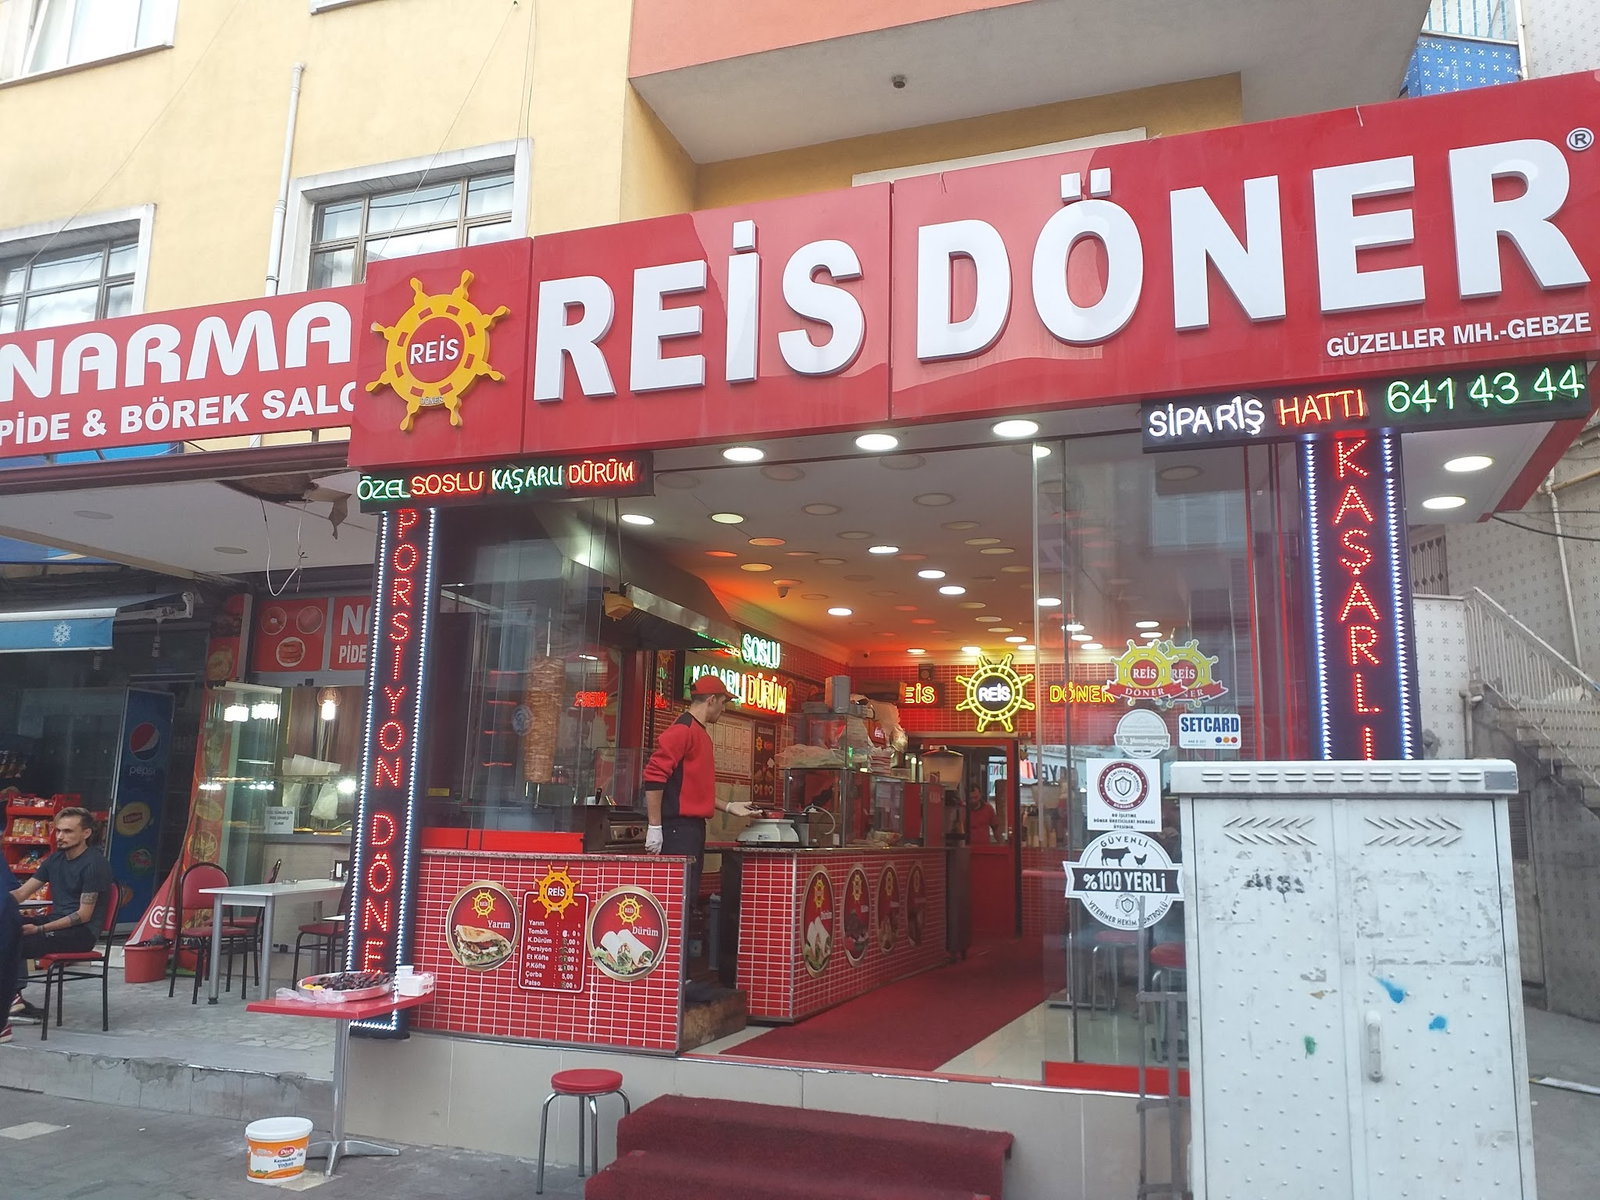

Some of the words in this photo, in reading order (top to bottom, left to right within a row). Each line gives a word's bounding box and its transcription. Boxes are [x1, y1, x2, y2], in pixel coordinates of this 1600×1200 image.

[534, 220, 866, 403] REİS
[917, 139, 1590, 362] DÖNER
[0, 301, 351, 402] NARMA
[410, 335, 459, 365] REİS
[1327, 328, 1446, 358] GÜZELLER
[1148, 396, 1266, 437] SİPARİŞ
[1279, 389, 1365, 426] HATTI
[1386, 377, 1454, 414] 641
[1469, 372, 1520, 408] 43
[1533, 365, 1585, 401] 44
[0, 411, 70, 446] PİDE
[82, 409, 107, 438] &
[121, 393, 250, 434] BÖREK
[357, 475, 411, 501] ÖZEL
[412, 471, 485, 496] SOSLU
[491, 465, 564, 494] KAŞARLI
[569, 459, 635, 484] DÜRÜM
[1334, 439, 1381, 761] KAŞARLI
[339, 641, 367, 664] PİDE
[742, 633, 781, 669] SOSLU
[1133, 666, 1157, 679] REİS
[905, 682, 936, 704] EİS
[978, 683, 1011, 702] REİS
[1181, 717, 1239, 732] SETCARD
[548, 886, 565, 897] REİS
[1083, 871, 1121, 890] %100
[1124, 871, 1166, 893] YERLİ
[488, 920, 511, 929] Yarım
[632, 927, 659, 937] Dürüm
